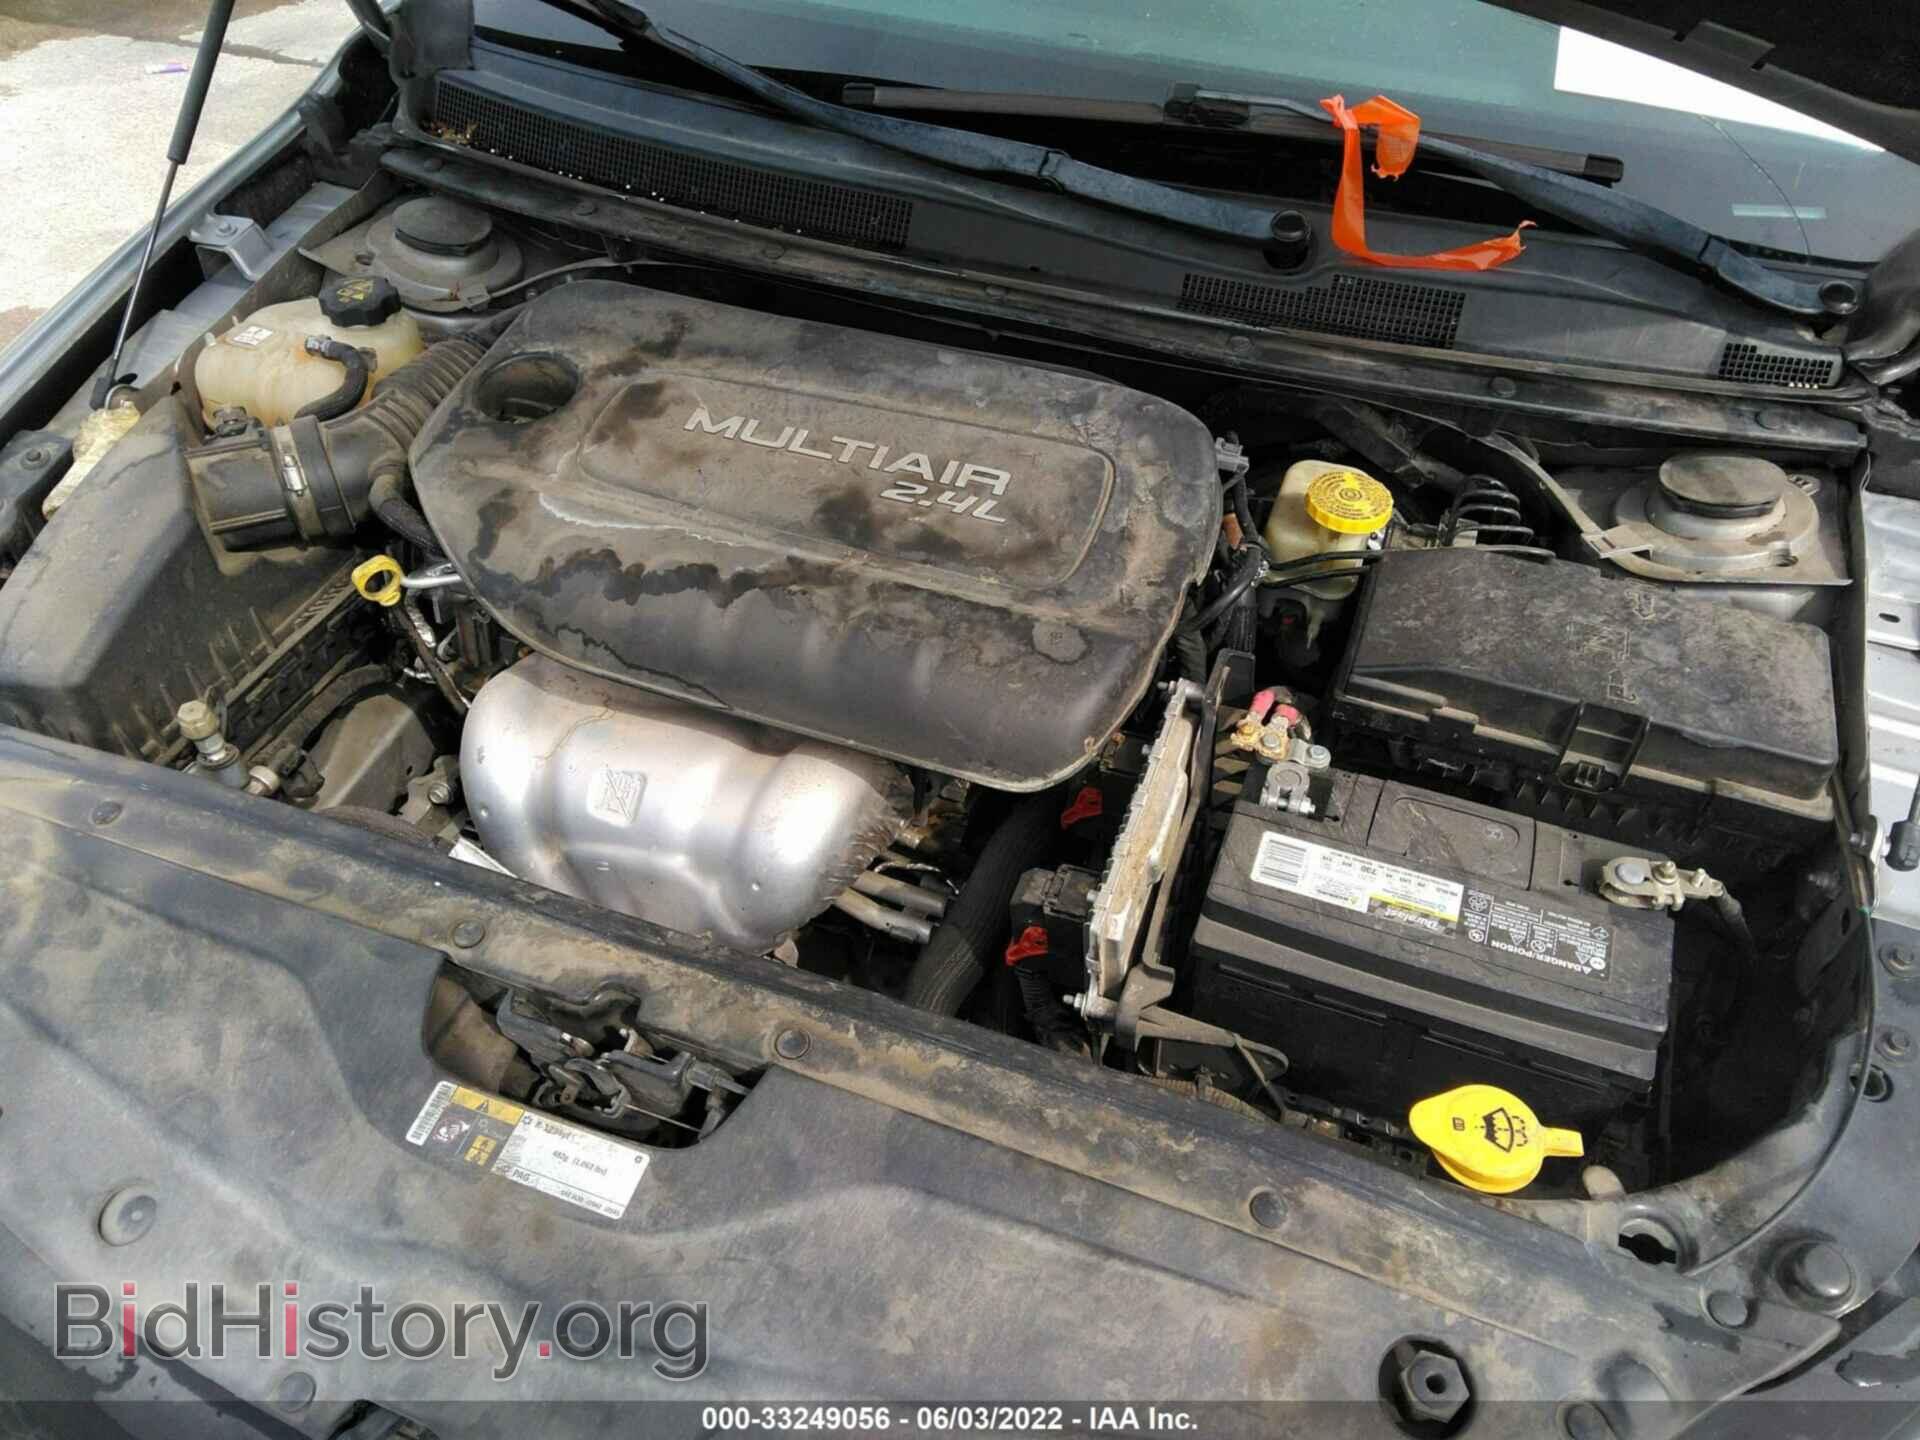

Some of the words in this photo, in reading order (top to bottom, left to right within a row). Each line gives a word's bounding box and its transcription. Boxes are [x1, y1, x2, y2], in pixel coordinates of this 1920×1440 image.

[684, 407, 1012, 496] MULTIAIR
[880, 480, 1007, 523] 2.4L
[1384, 907, 1439, 930] Duralast
[1490, 939, 1582, 972] DANGER/POISON
